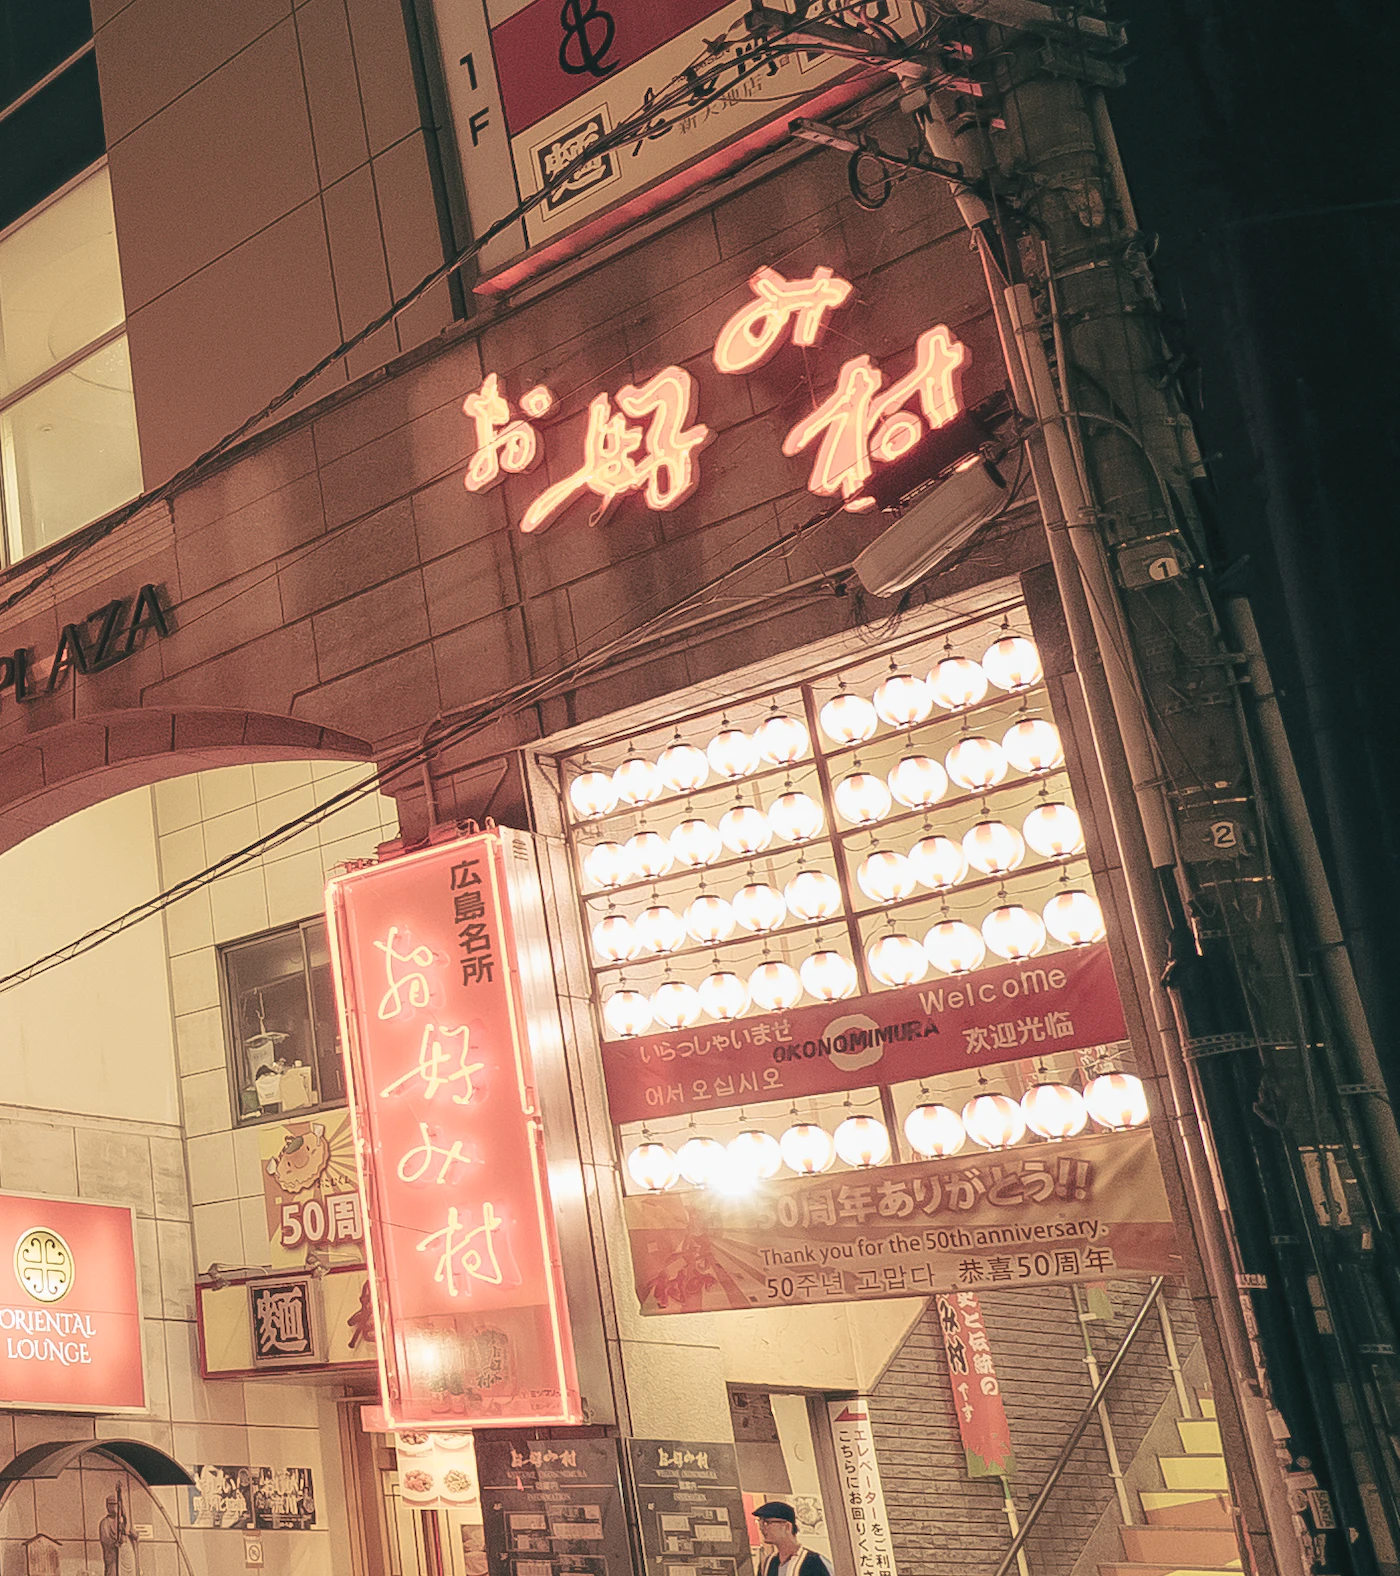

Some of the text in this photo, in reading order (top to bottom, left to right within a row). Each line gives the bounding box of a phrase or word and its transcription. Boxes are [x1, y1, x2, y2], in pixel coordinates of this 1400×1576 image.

[464, 265, 973, 533] お好み村
[449, 859, 496, 987] 広島名所
[919, 966, 1068, 1016] Welcome
[639, 1018, 793, 1064] いらっしゃいませ
[772, 1017, 942, 1064] OKONOMIMURA
[961, 1011, 1075, 1055] 欢迎光临
[645, 1067, 784, 1108] 어서 오십시오
[374, 926, 504, 1297] お好み村
[760, 1218, 1109, 1267] Thank you for the 50th anniversary.
[957, 1247, 1115, 1285] 恭喜50周年
[7, 1338, 92, 1366] LOUNGE
